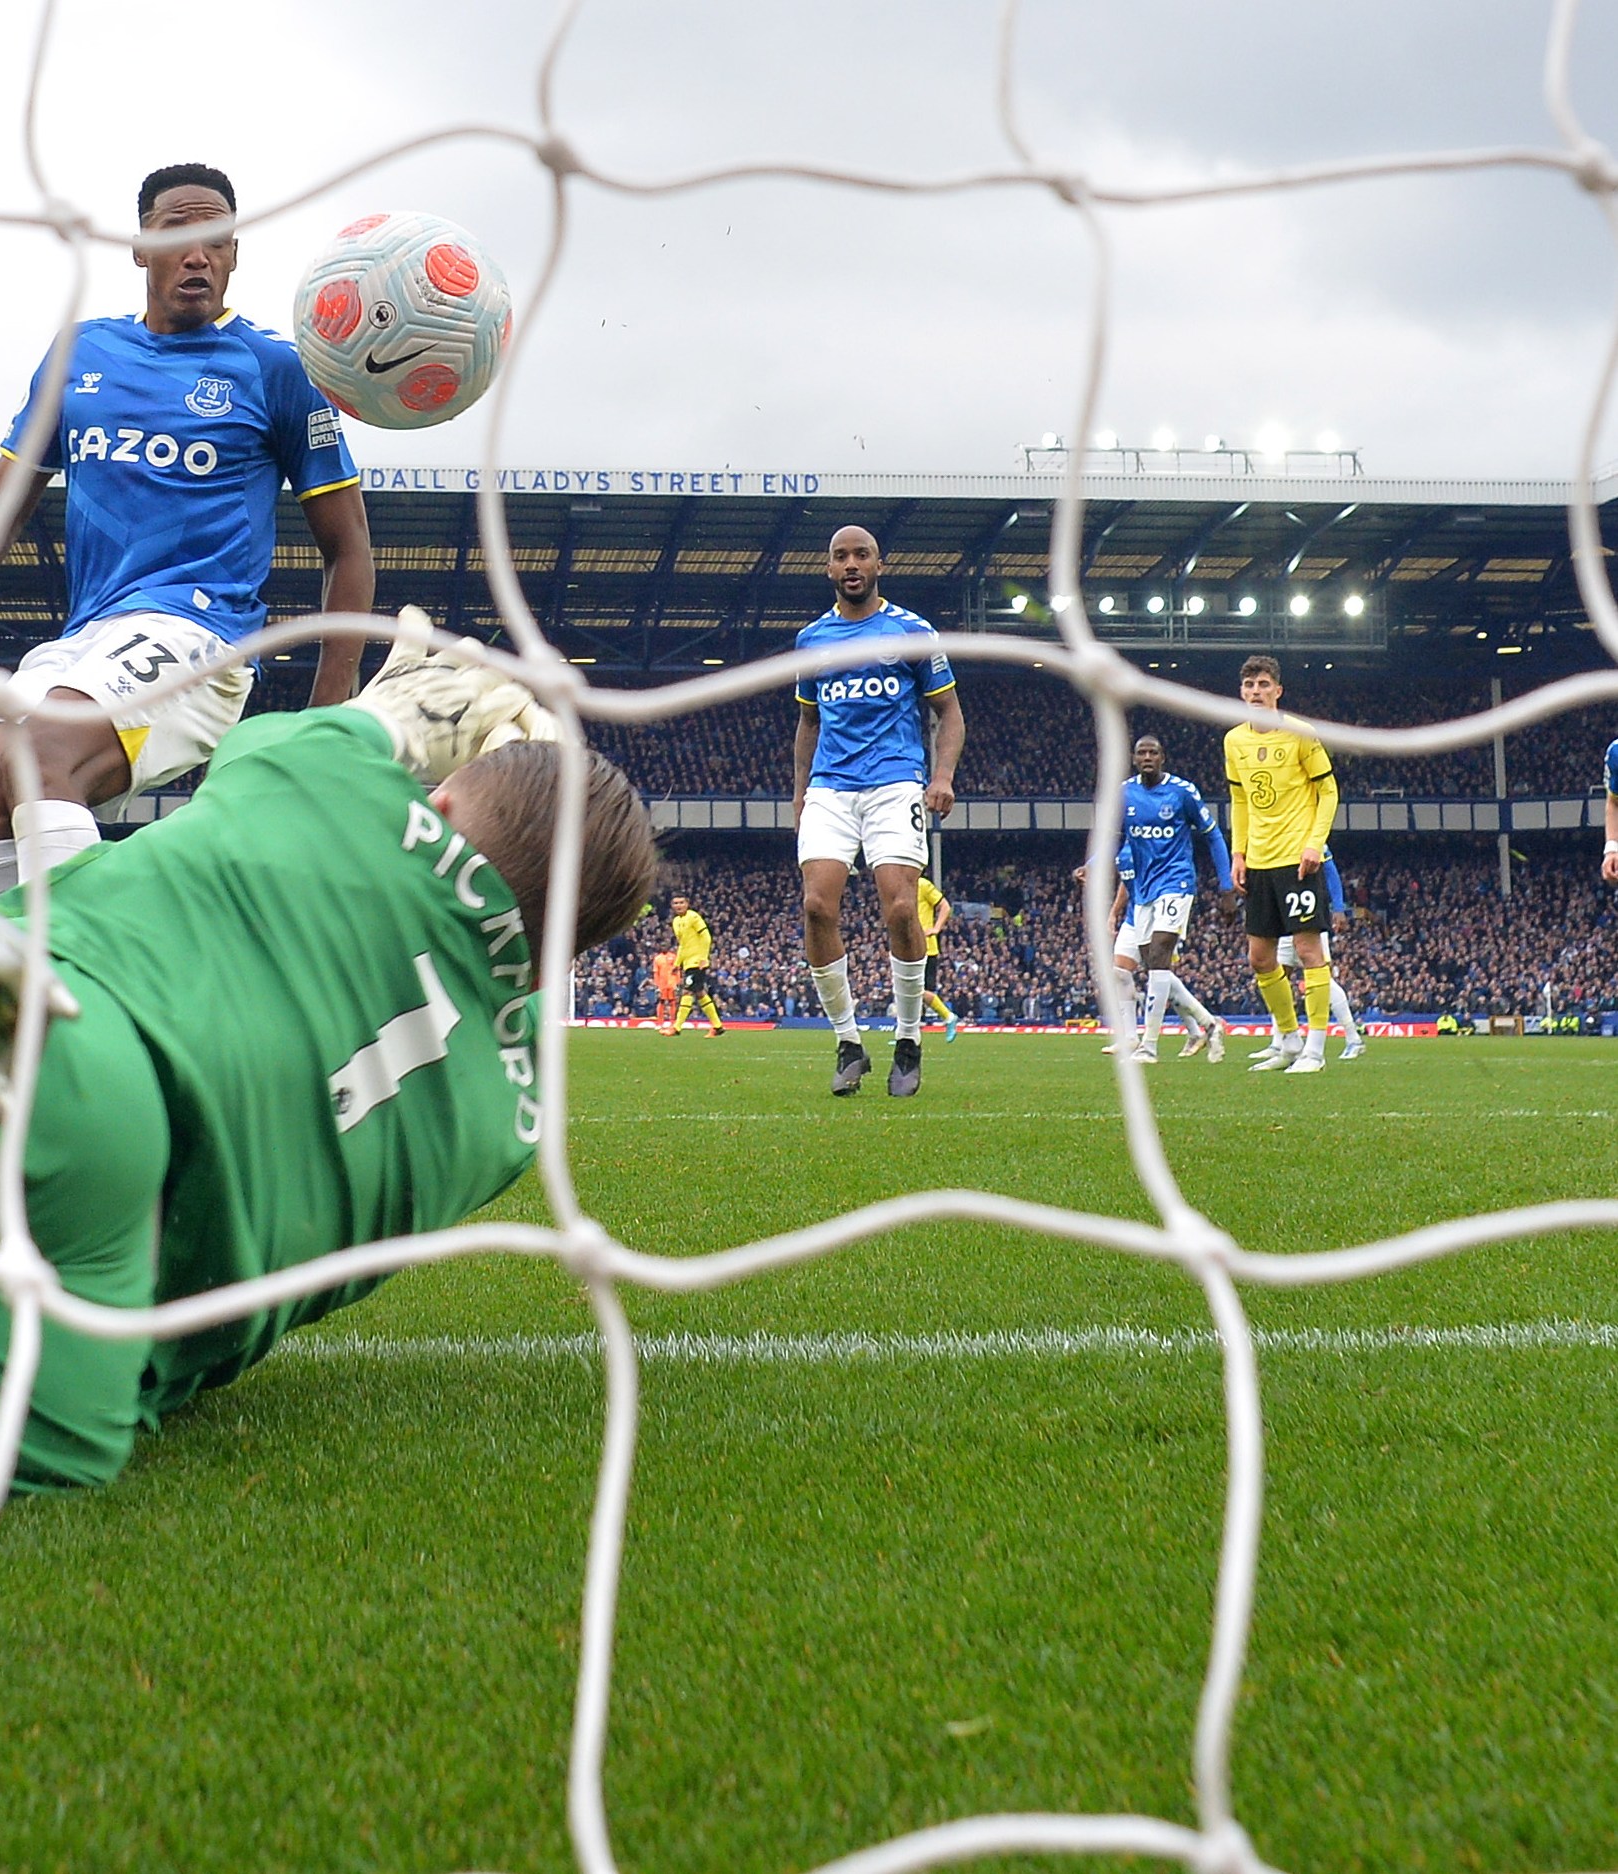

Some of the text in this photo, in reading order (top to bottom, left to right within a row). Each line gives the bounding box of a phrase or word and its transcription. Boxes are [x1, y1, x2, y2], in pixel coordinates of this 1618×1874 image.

[68, 426, 218, 476] CAZOO
[631, 472, 743, 493] STREET
[763, 474, 819, 494] END
[105, 633, 179, 683] 13
[821, 676, 900, 702] CAZOO
[1250, 770, 1277, 809] 3
[910, 802, 924, 833] 8
[1161, 899, 1178, 917] 16
[1285, 890, 1316, 918] 29
[328, 951, 462, 1134] 1
